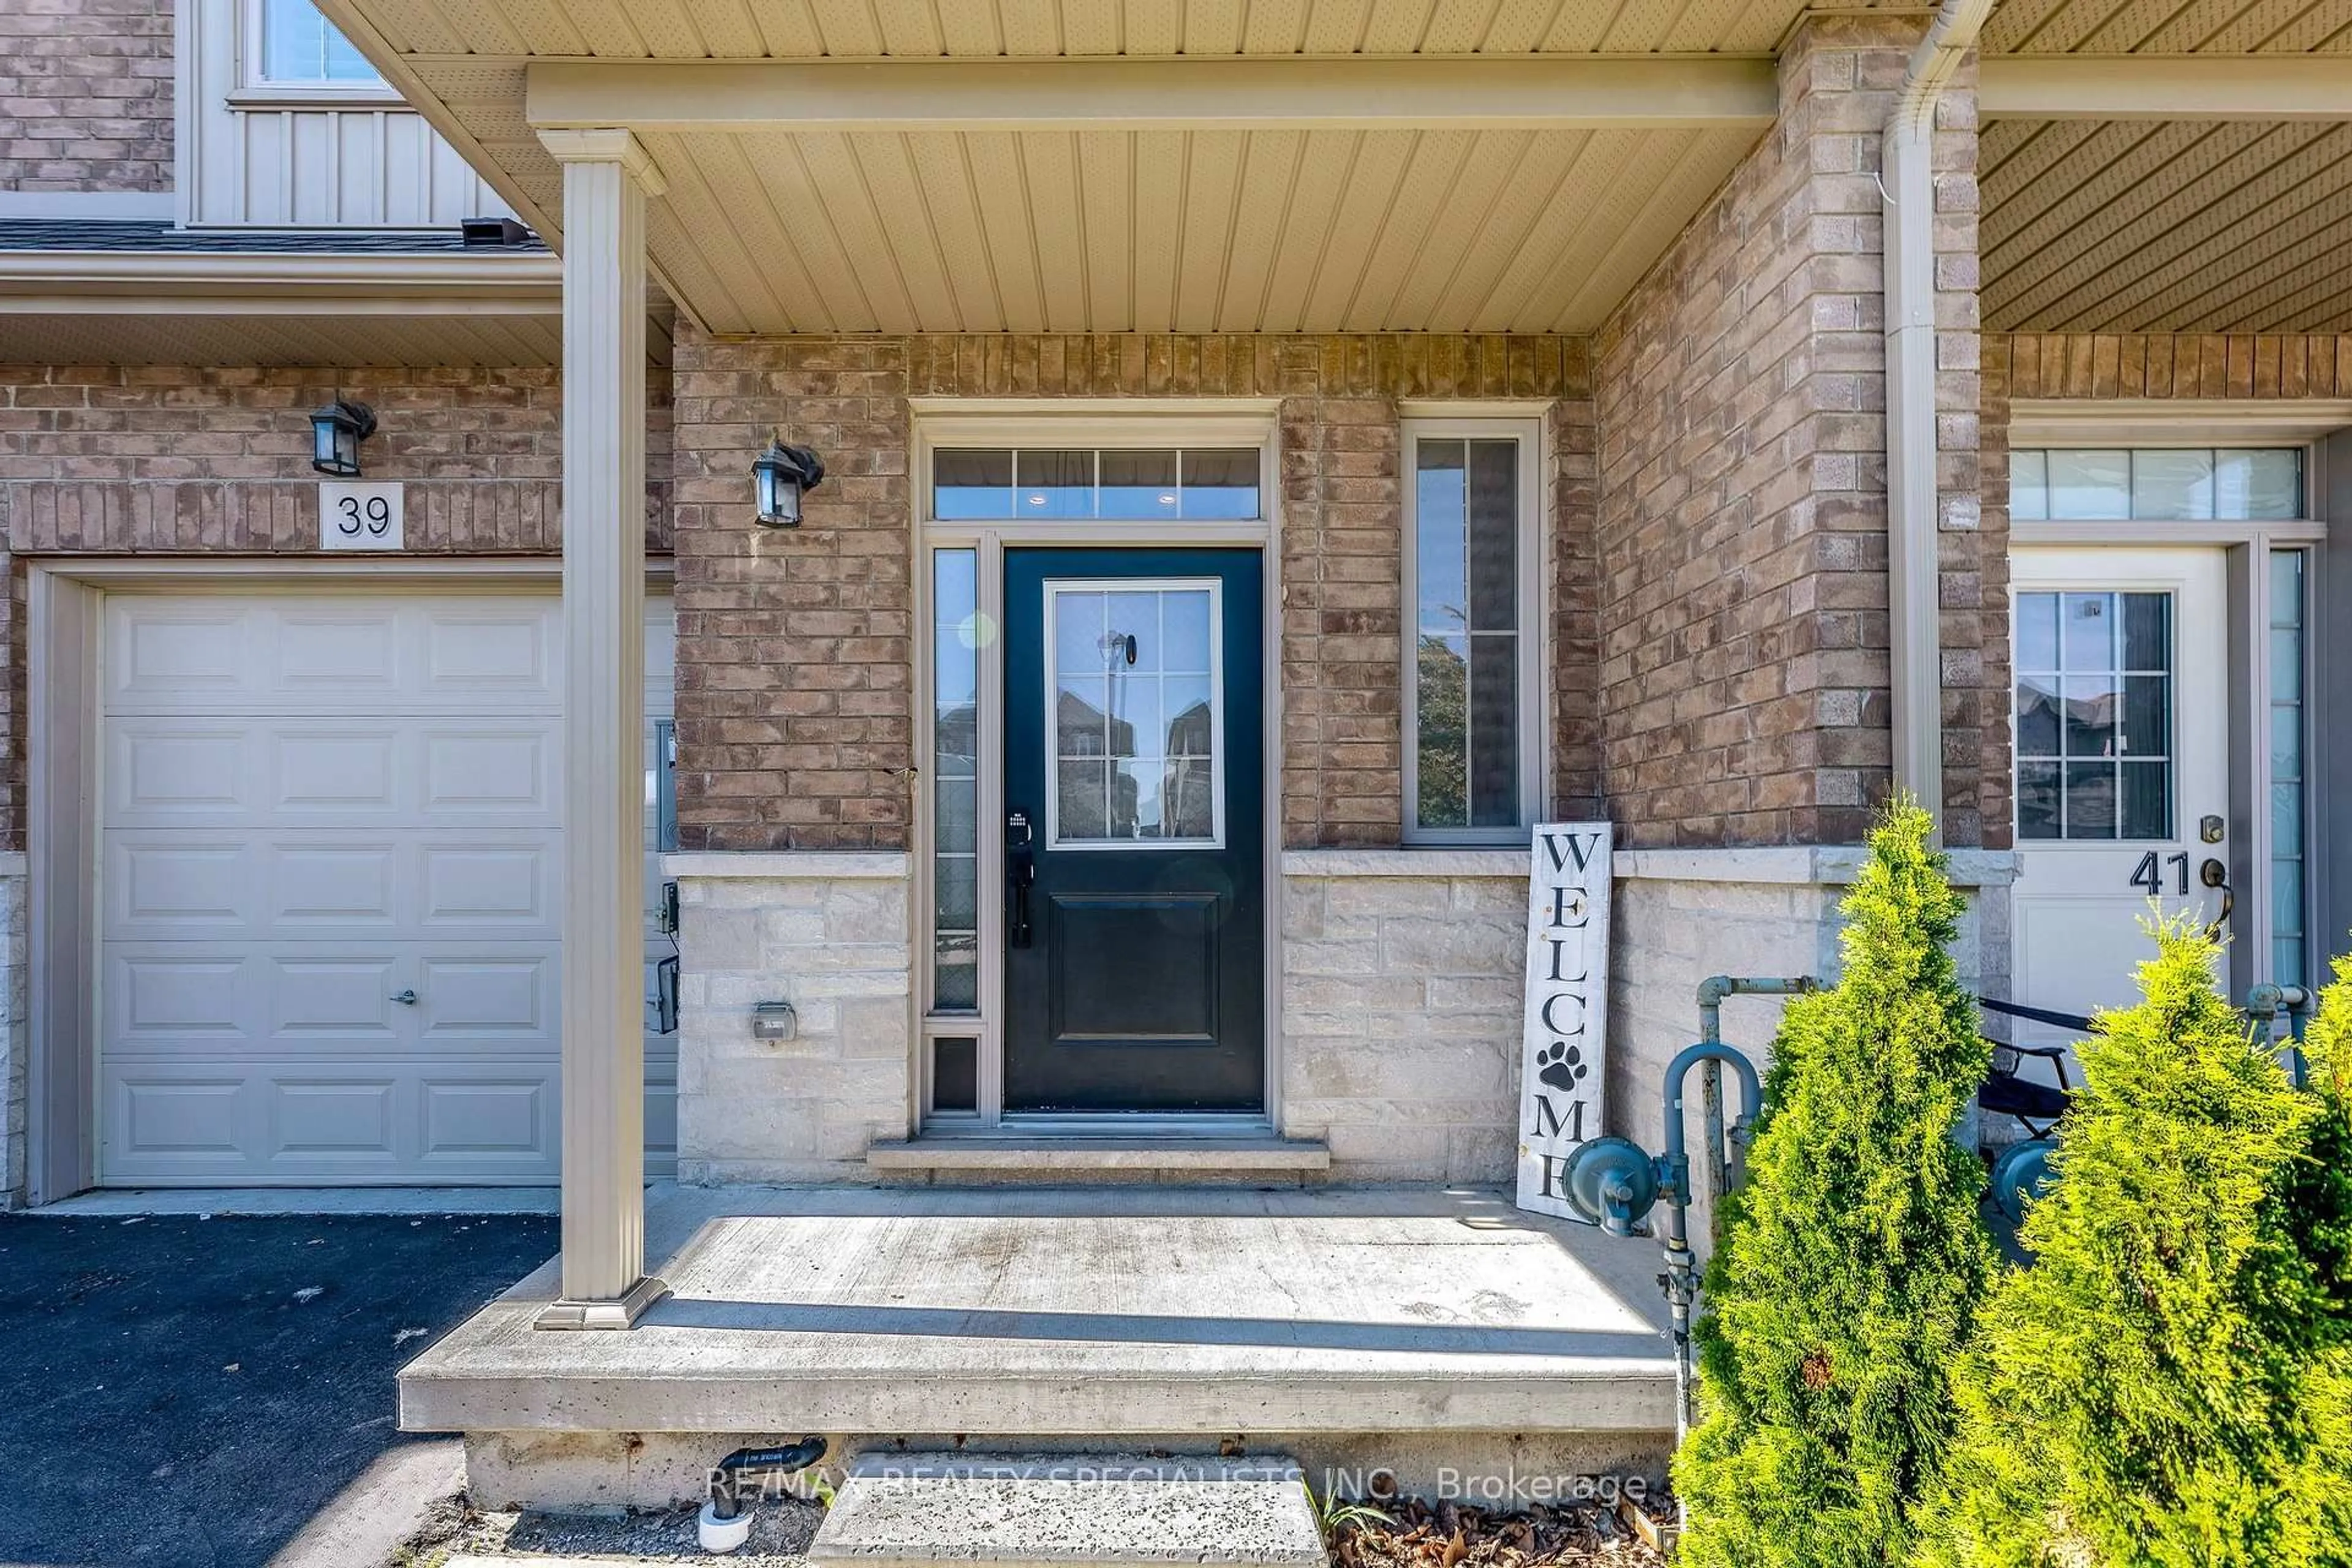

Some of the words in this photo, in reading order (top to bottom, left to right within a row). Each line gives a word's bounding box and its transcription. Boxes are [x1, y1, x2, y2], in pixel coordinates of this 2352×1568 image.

[339, 497, 388, 534] 39
[2130, 850, 2188, 895] 41
[1531, 833, 1602, 1201] WELCME
